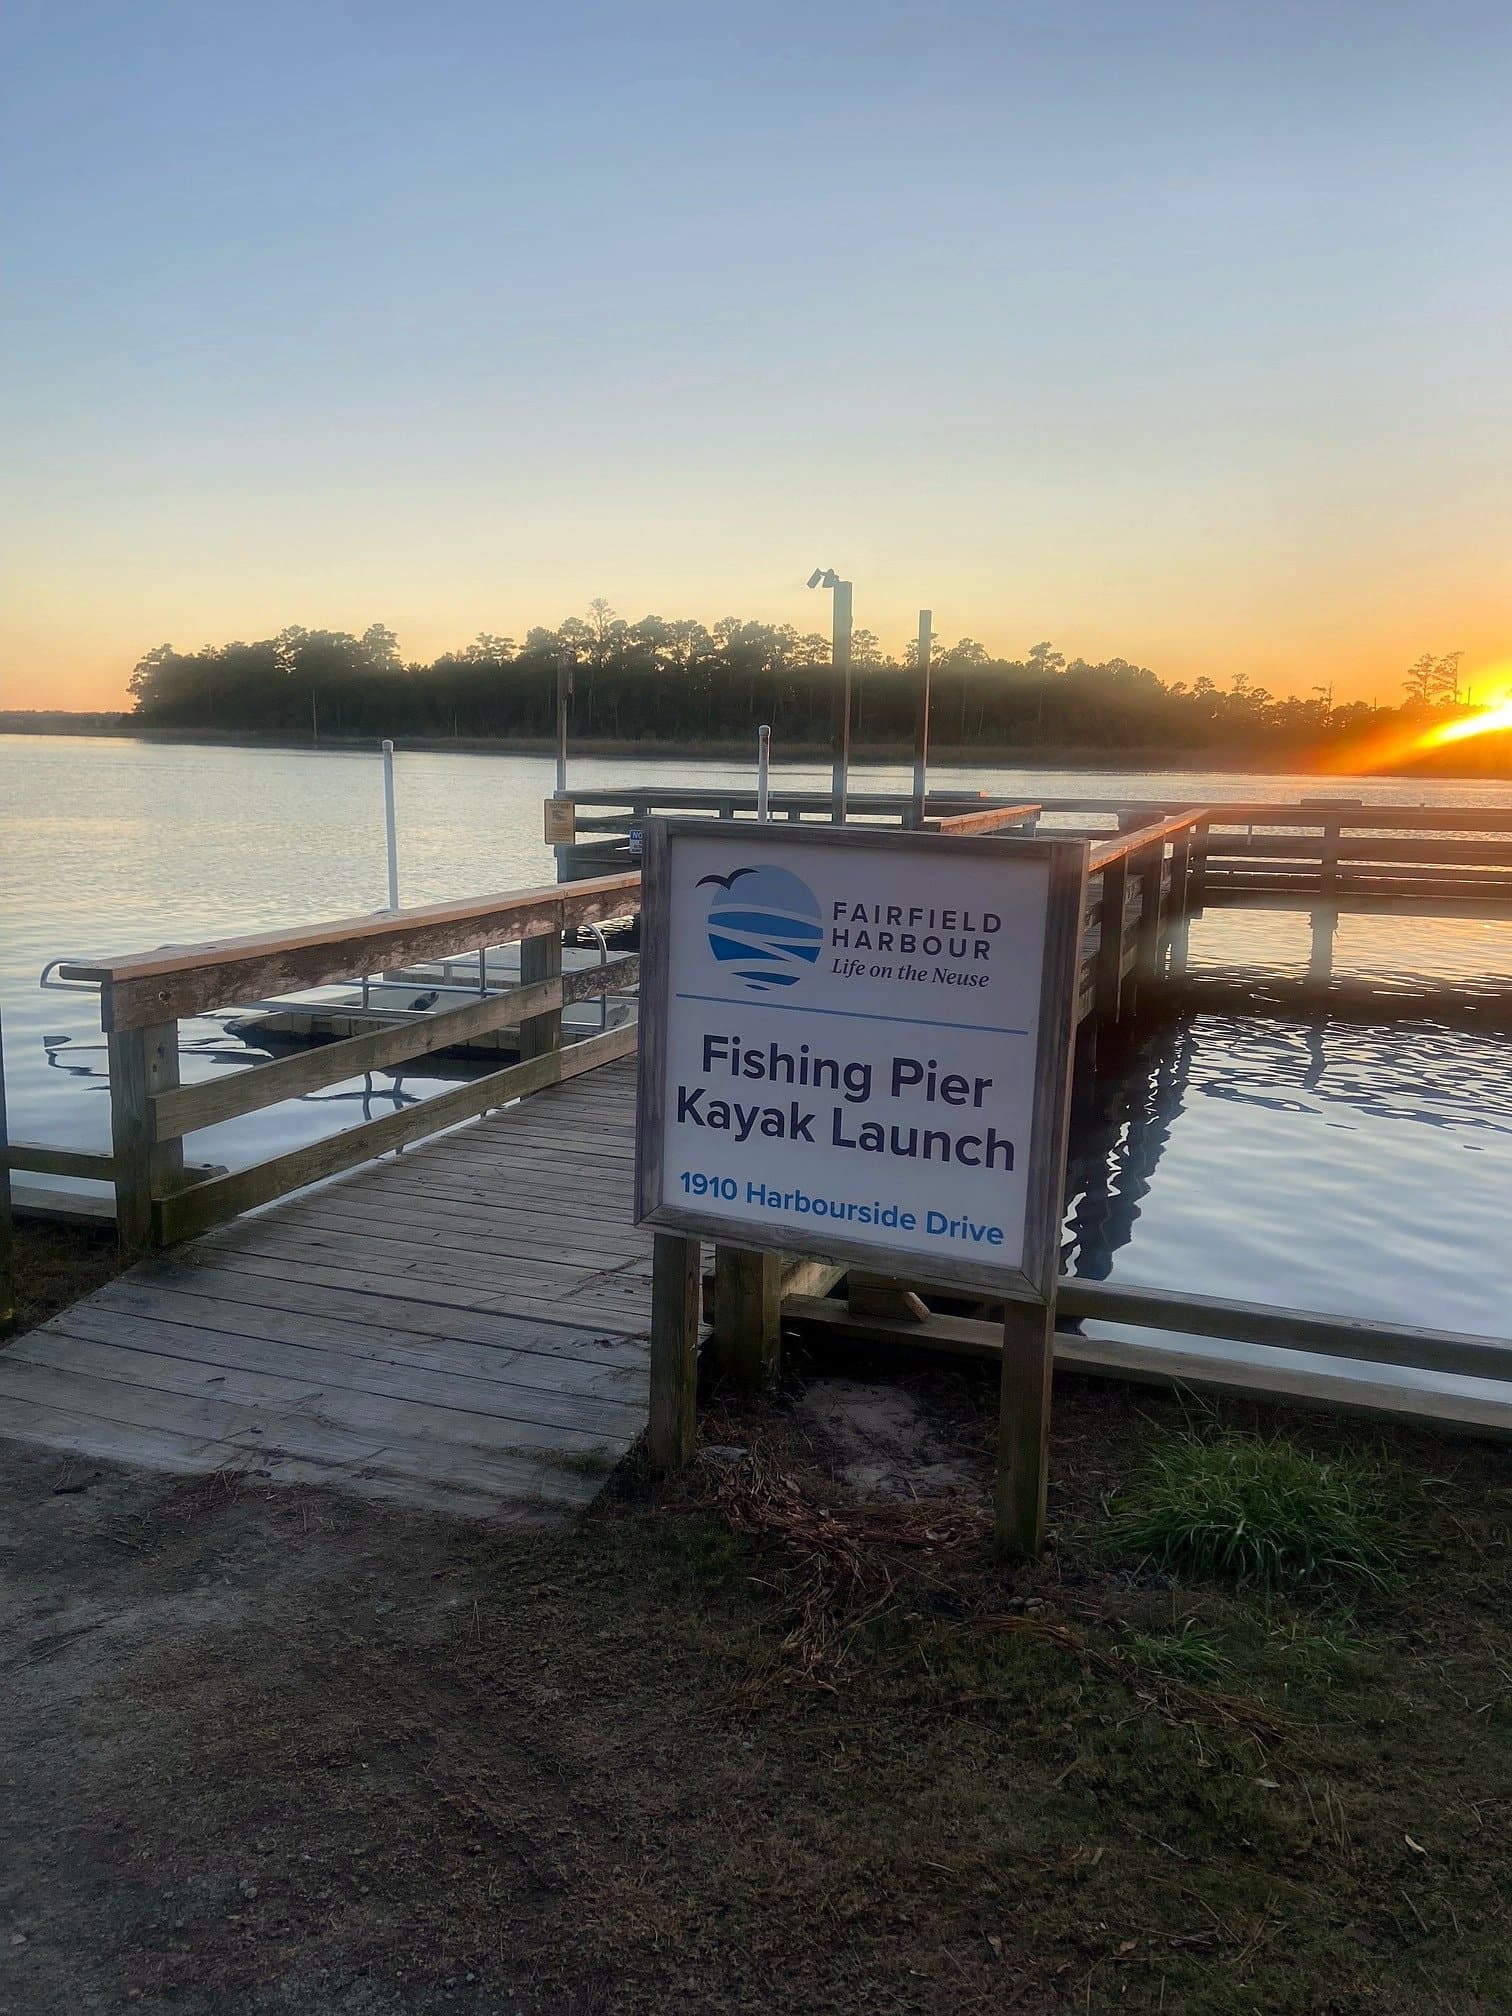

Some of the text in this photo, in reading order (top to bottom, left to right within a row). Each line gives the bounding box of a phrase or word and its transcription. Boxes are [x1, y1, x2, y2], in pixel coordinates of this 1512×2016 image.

[831, 928, 992, 960] HARBOUR
[833, 902, 1002, 934] FAIRFIELD
[832, 958, 990, 988] Life on the Neuse
[702, 1034, 993, 1108] Fishing Pier
[677, 1086, 1015, 1172] Kayak Launch
[680, 1171, 1005, 1246] 1910 Harbourside Drive
